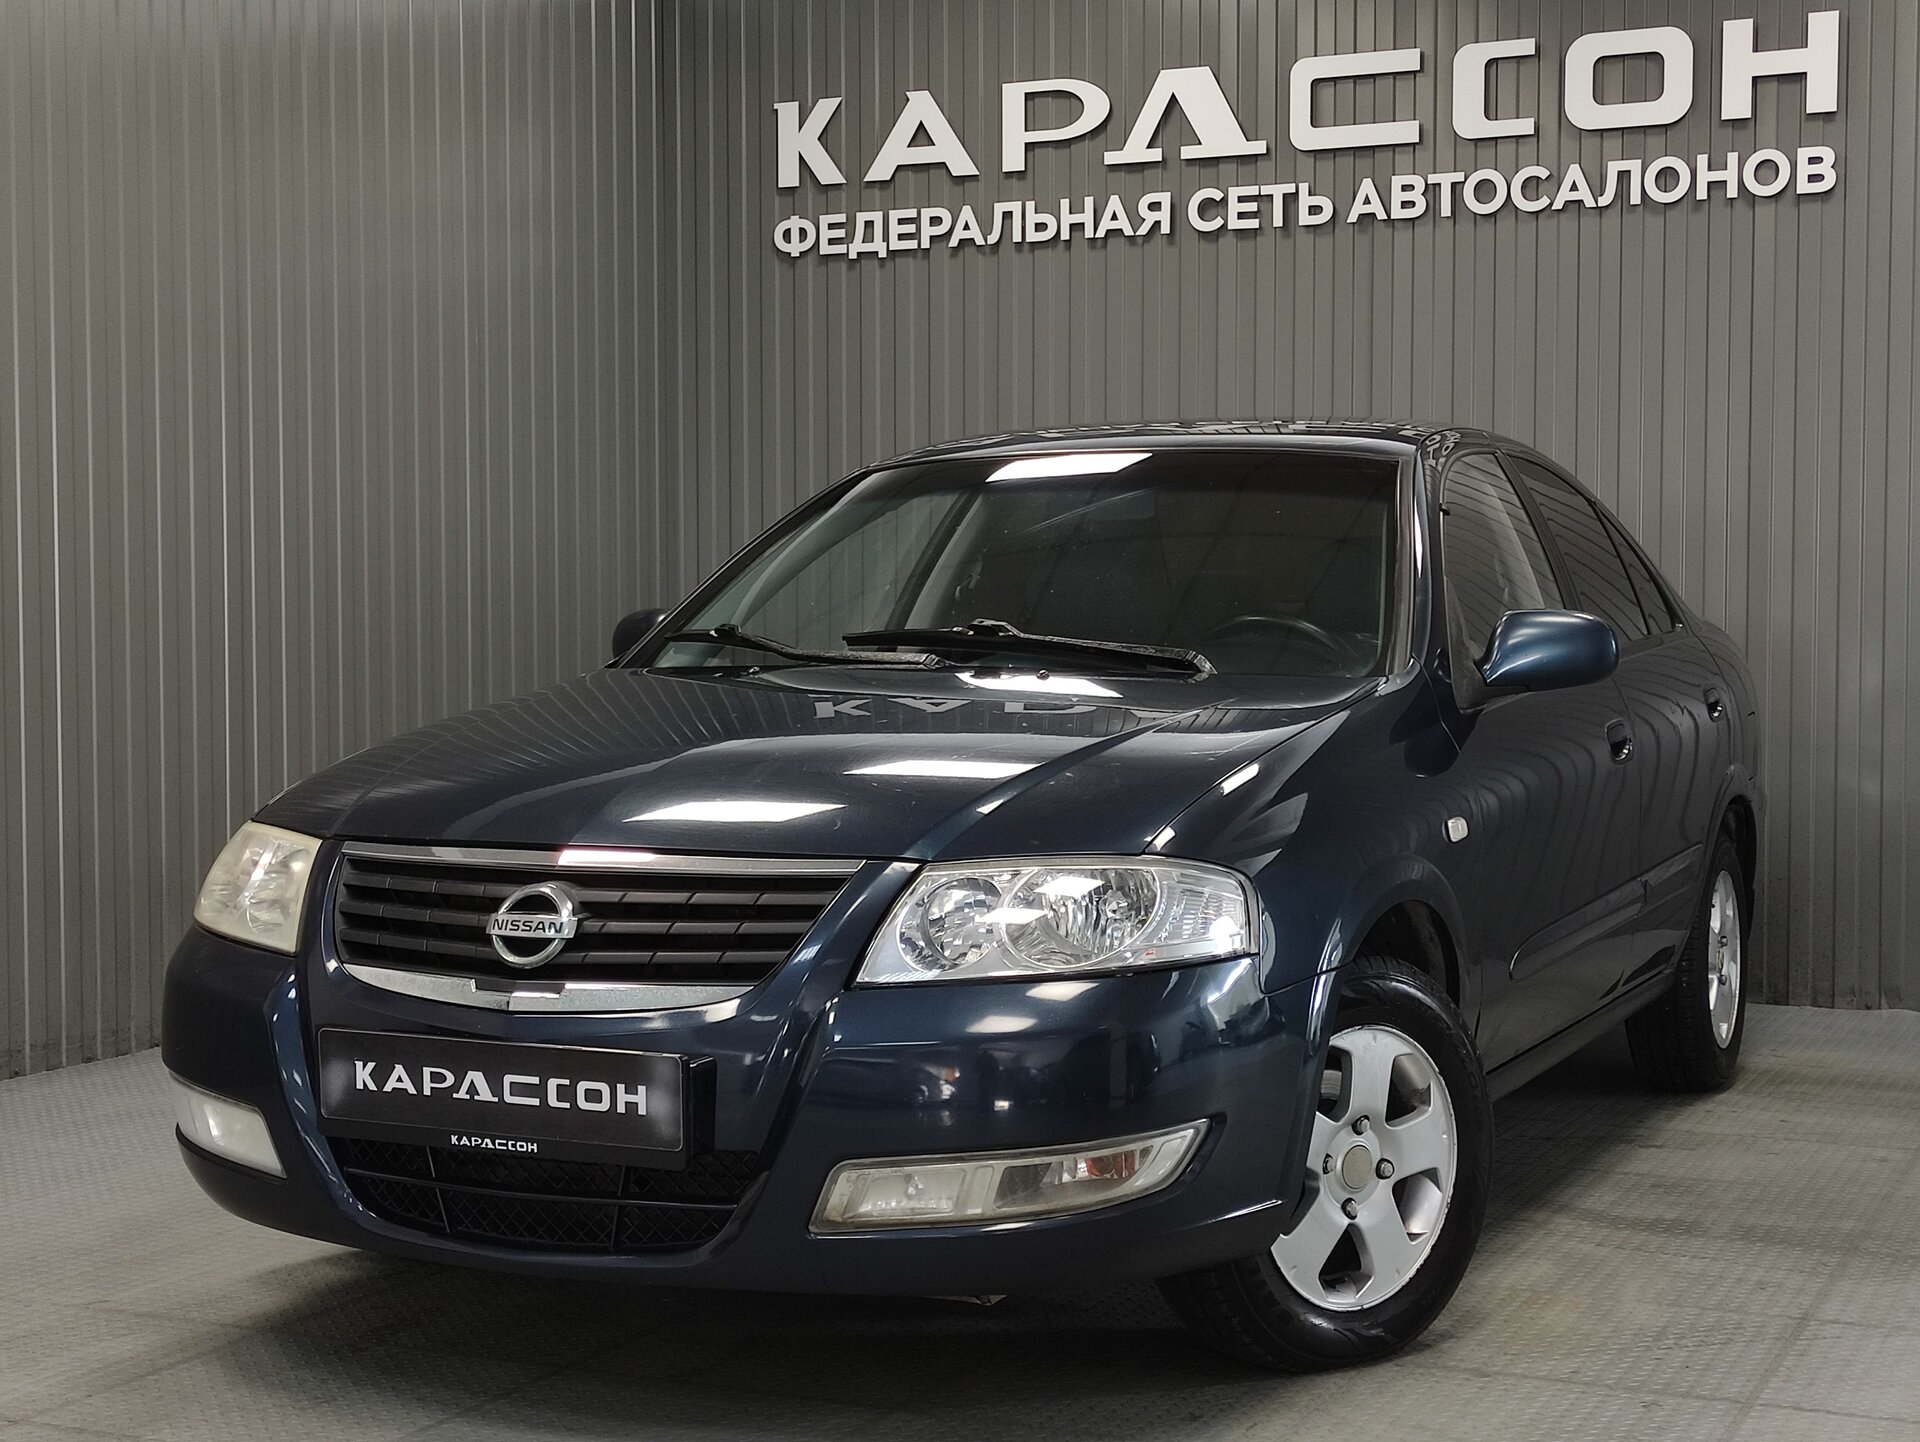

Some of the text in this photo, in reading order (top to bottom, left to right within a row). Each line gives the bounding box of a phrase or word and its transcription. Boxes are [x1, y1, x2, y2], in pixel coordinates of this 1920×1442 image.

[774, 145, 1838, 259] ФЕДЕРАЛЬНАЯ СЕТЬ АВТОСАЛОНОВ
[492, 918, 564, 934] NISSAN
